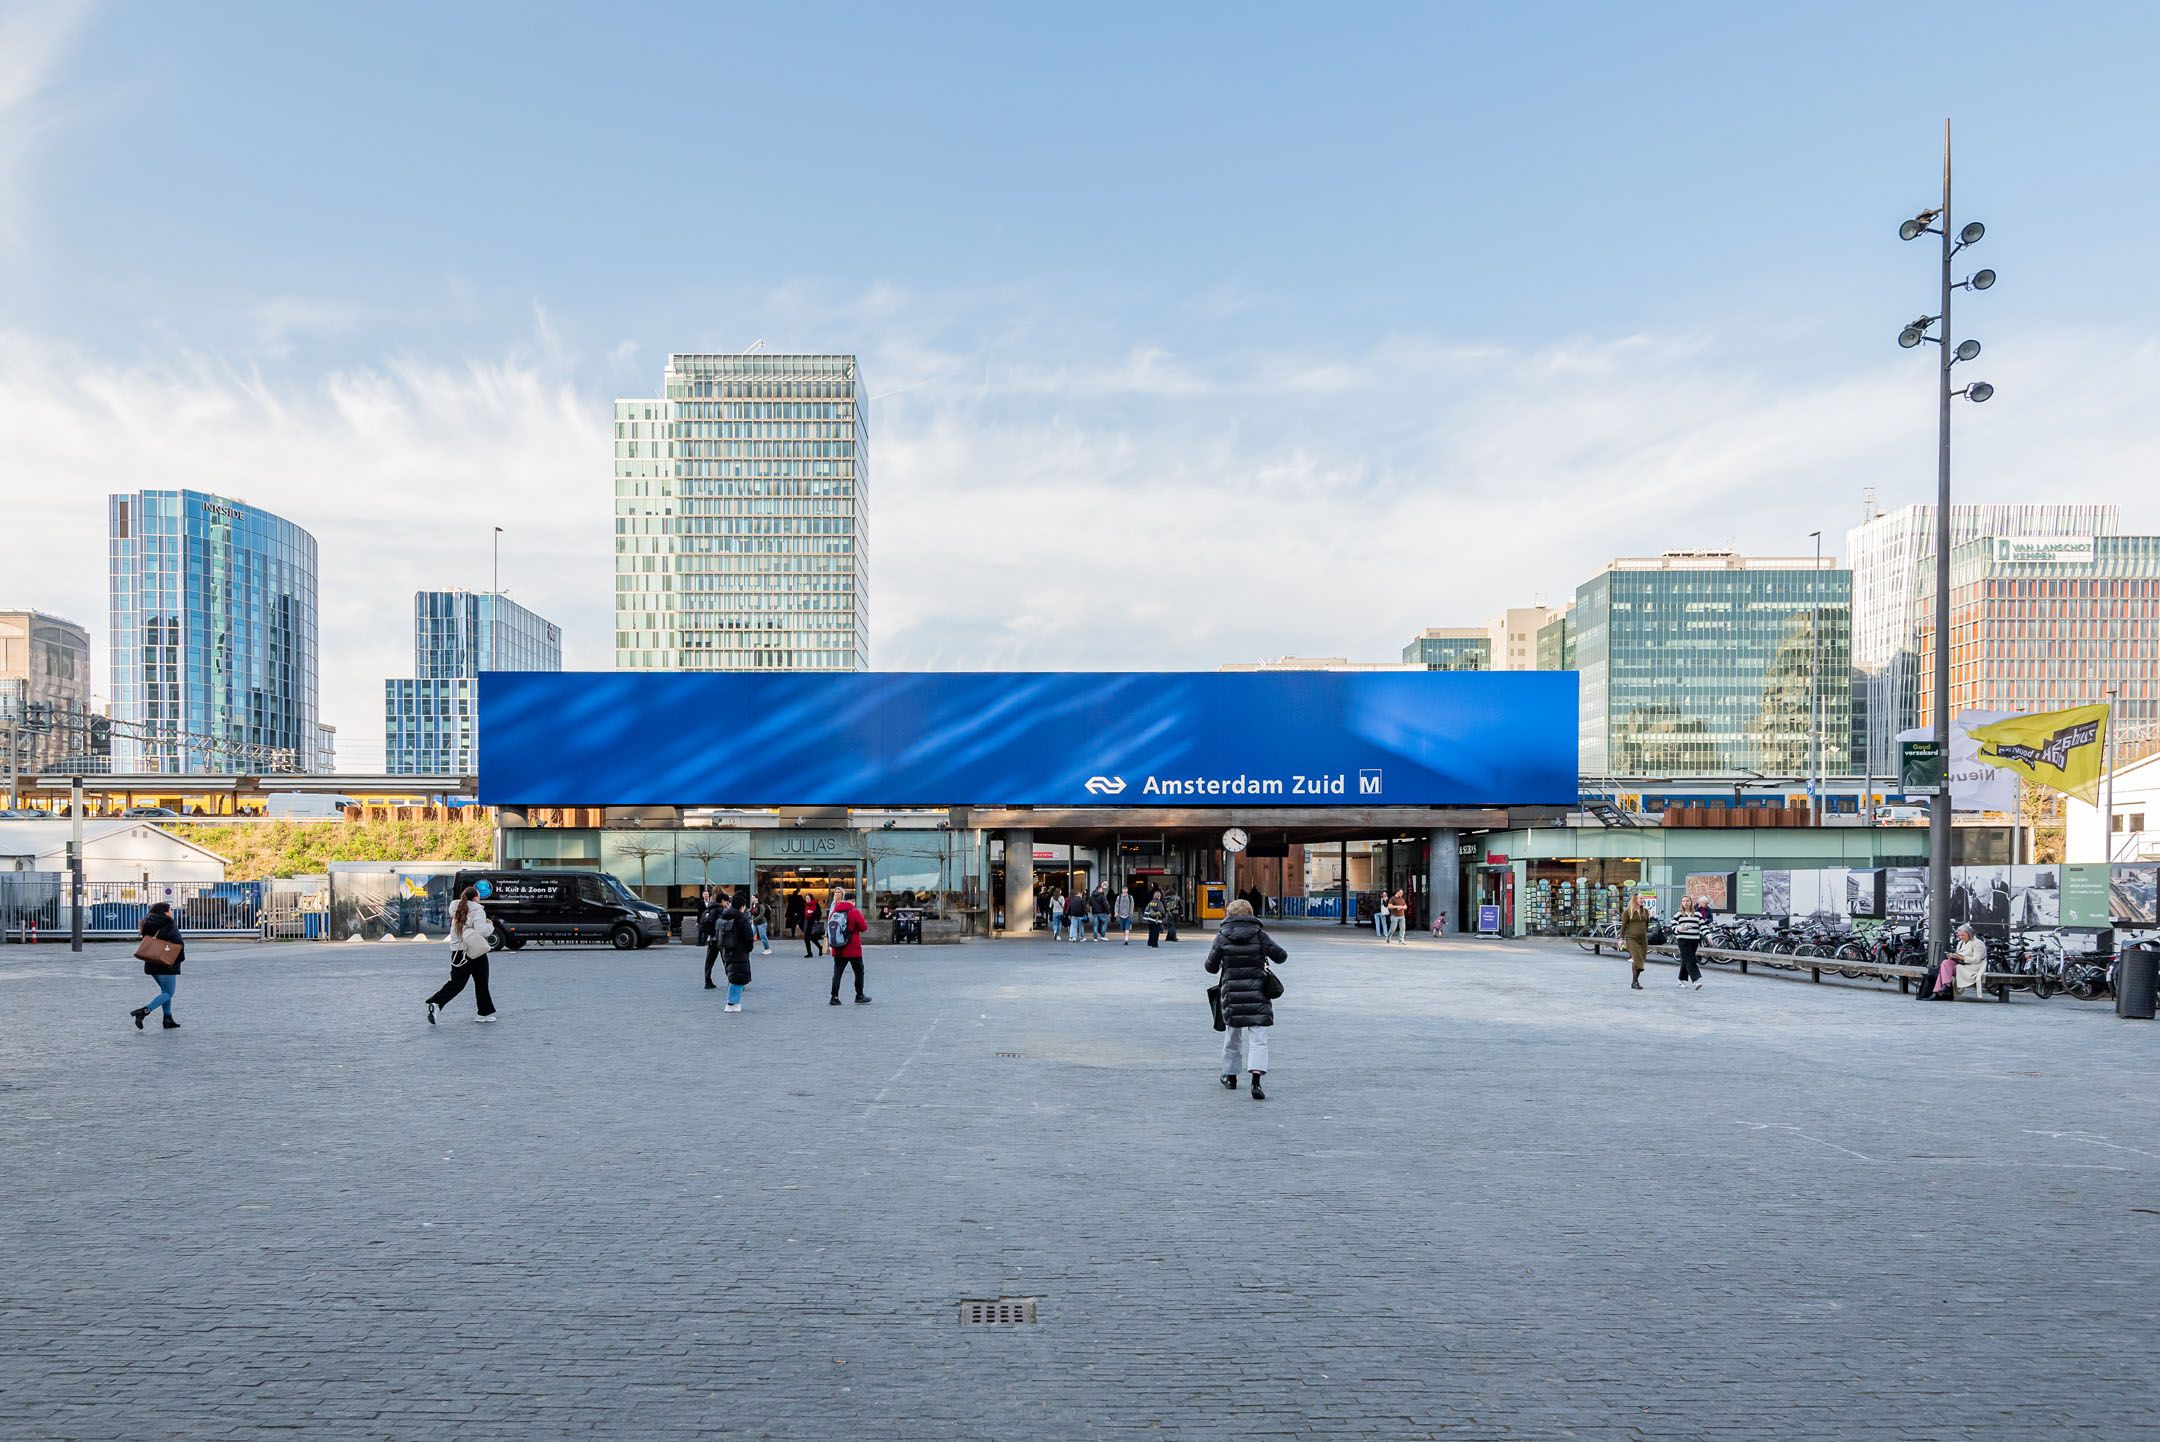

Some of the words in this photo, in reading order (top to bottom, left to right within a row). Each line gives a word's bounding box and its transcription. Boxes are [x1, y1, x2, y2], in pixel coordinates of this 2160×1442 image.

[201, 501, 245, 521] INNSIDE
[2012, 543, 2034, 552] VAN
[2036, 543, 2092, 552] LANSCHOT
[2012, 552, 2056, 560] KEMPEN
[1142, 774, 1283, 795] Amsterdam
[1292, 774, 1345, 794] Zuid
[1360, 776, 1380, 794] M
[781, 838, 836, 853] JULIA'S
